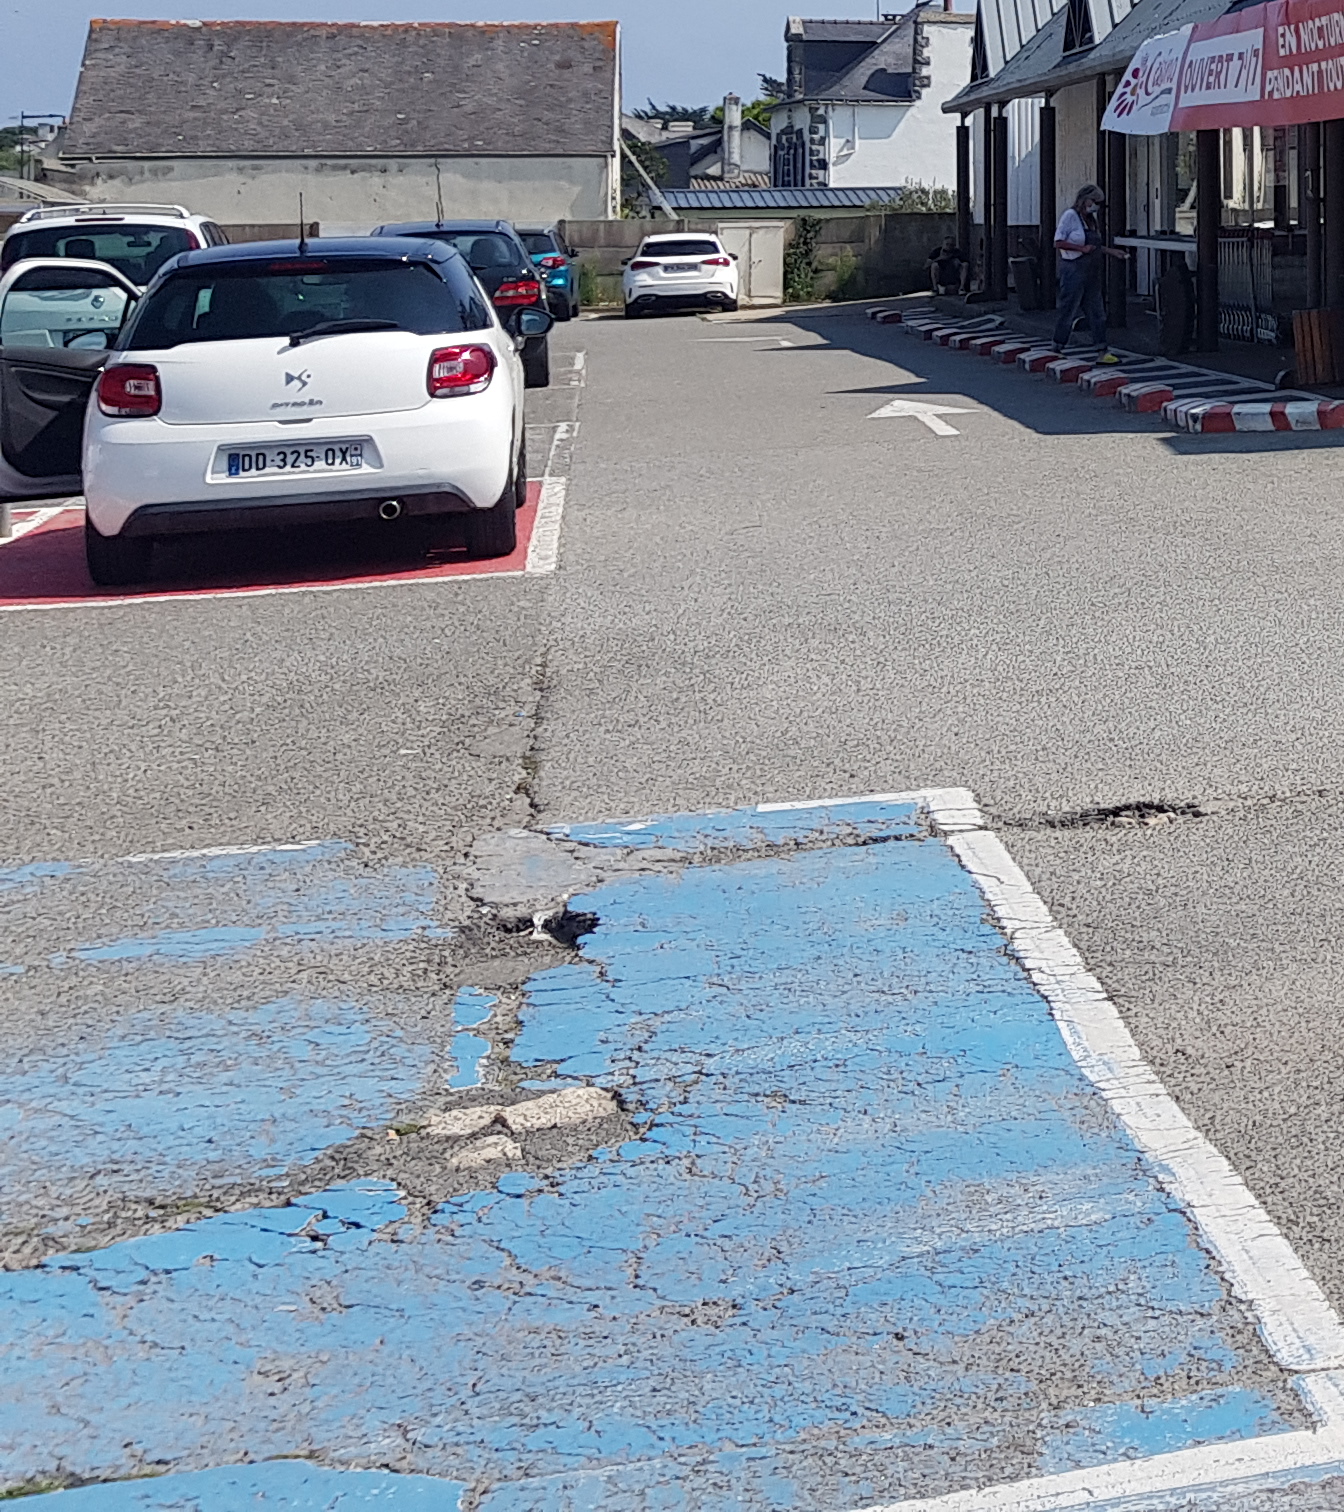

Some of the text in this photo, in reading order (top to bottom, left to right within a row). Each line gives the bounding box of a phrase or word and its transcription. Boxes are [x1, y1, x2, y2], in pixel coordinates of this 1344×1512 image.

[1277, 24, 1297, 57] EN
[1183, 52, 1235, 95] OUVERT
[1264, 62, 1320, 100] PENDANT
